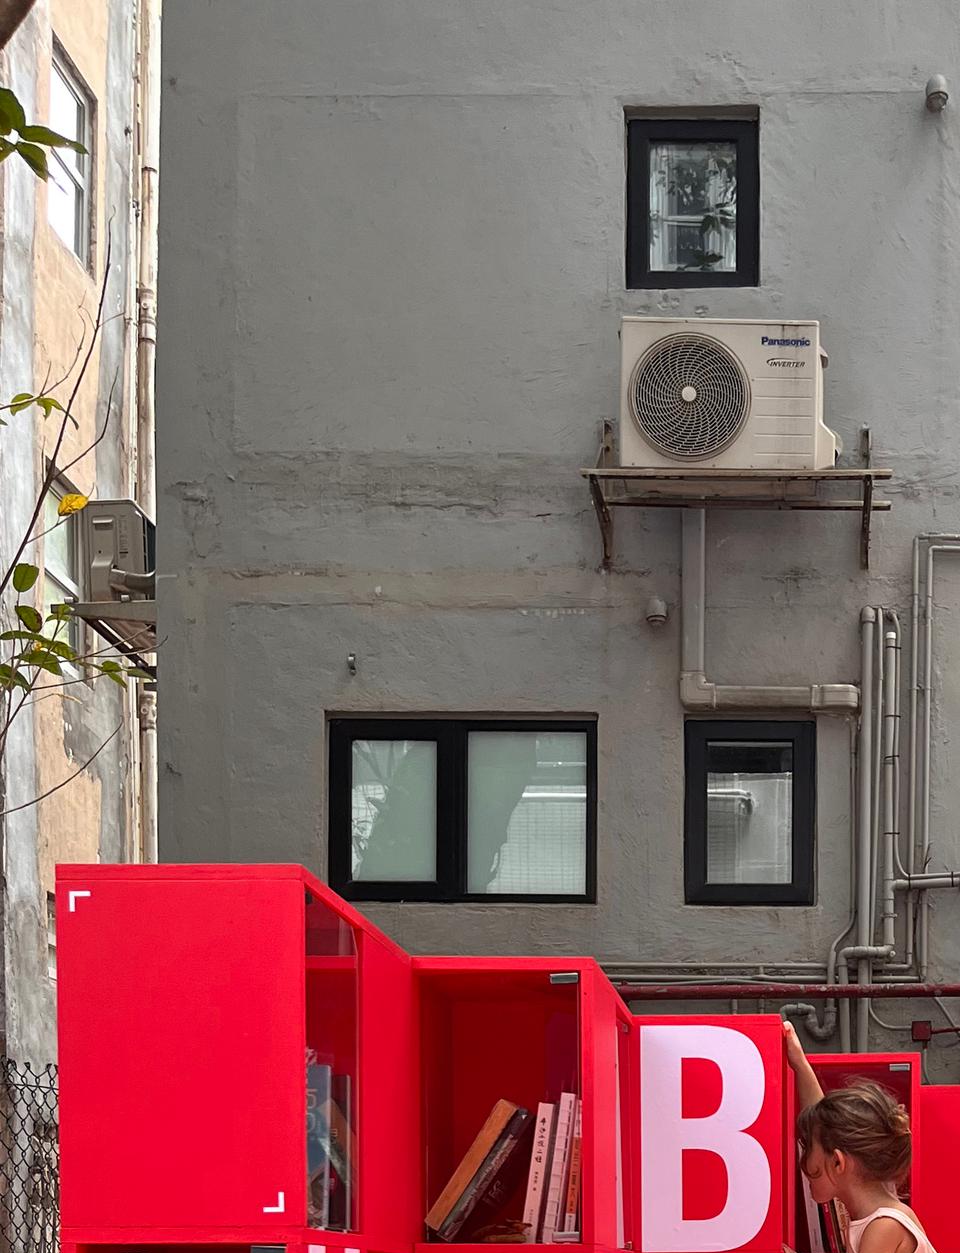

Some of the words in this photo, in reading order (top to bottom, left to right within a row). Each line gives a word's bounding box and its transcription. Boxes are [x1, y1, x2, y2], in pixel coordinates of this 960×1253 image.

[761, 336, 811, 347] Panasonic
[768, 360, 806, 368] INVERTER
[640, 1025, 770, 1252] B
